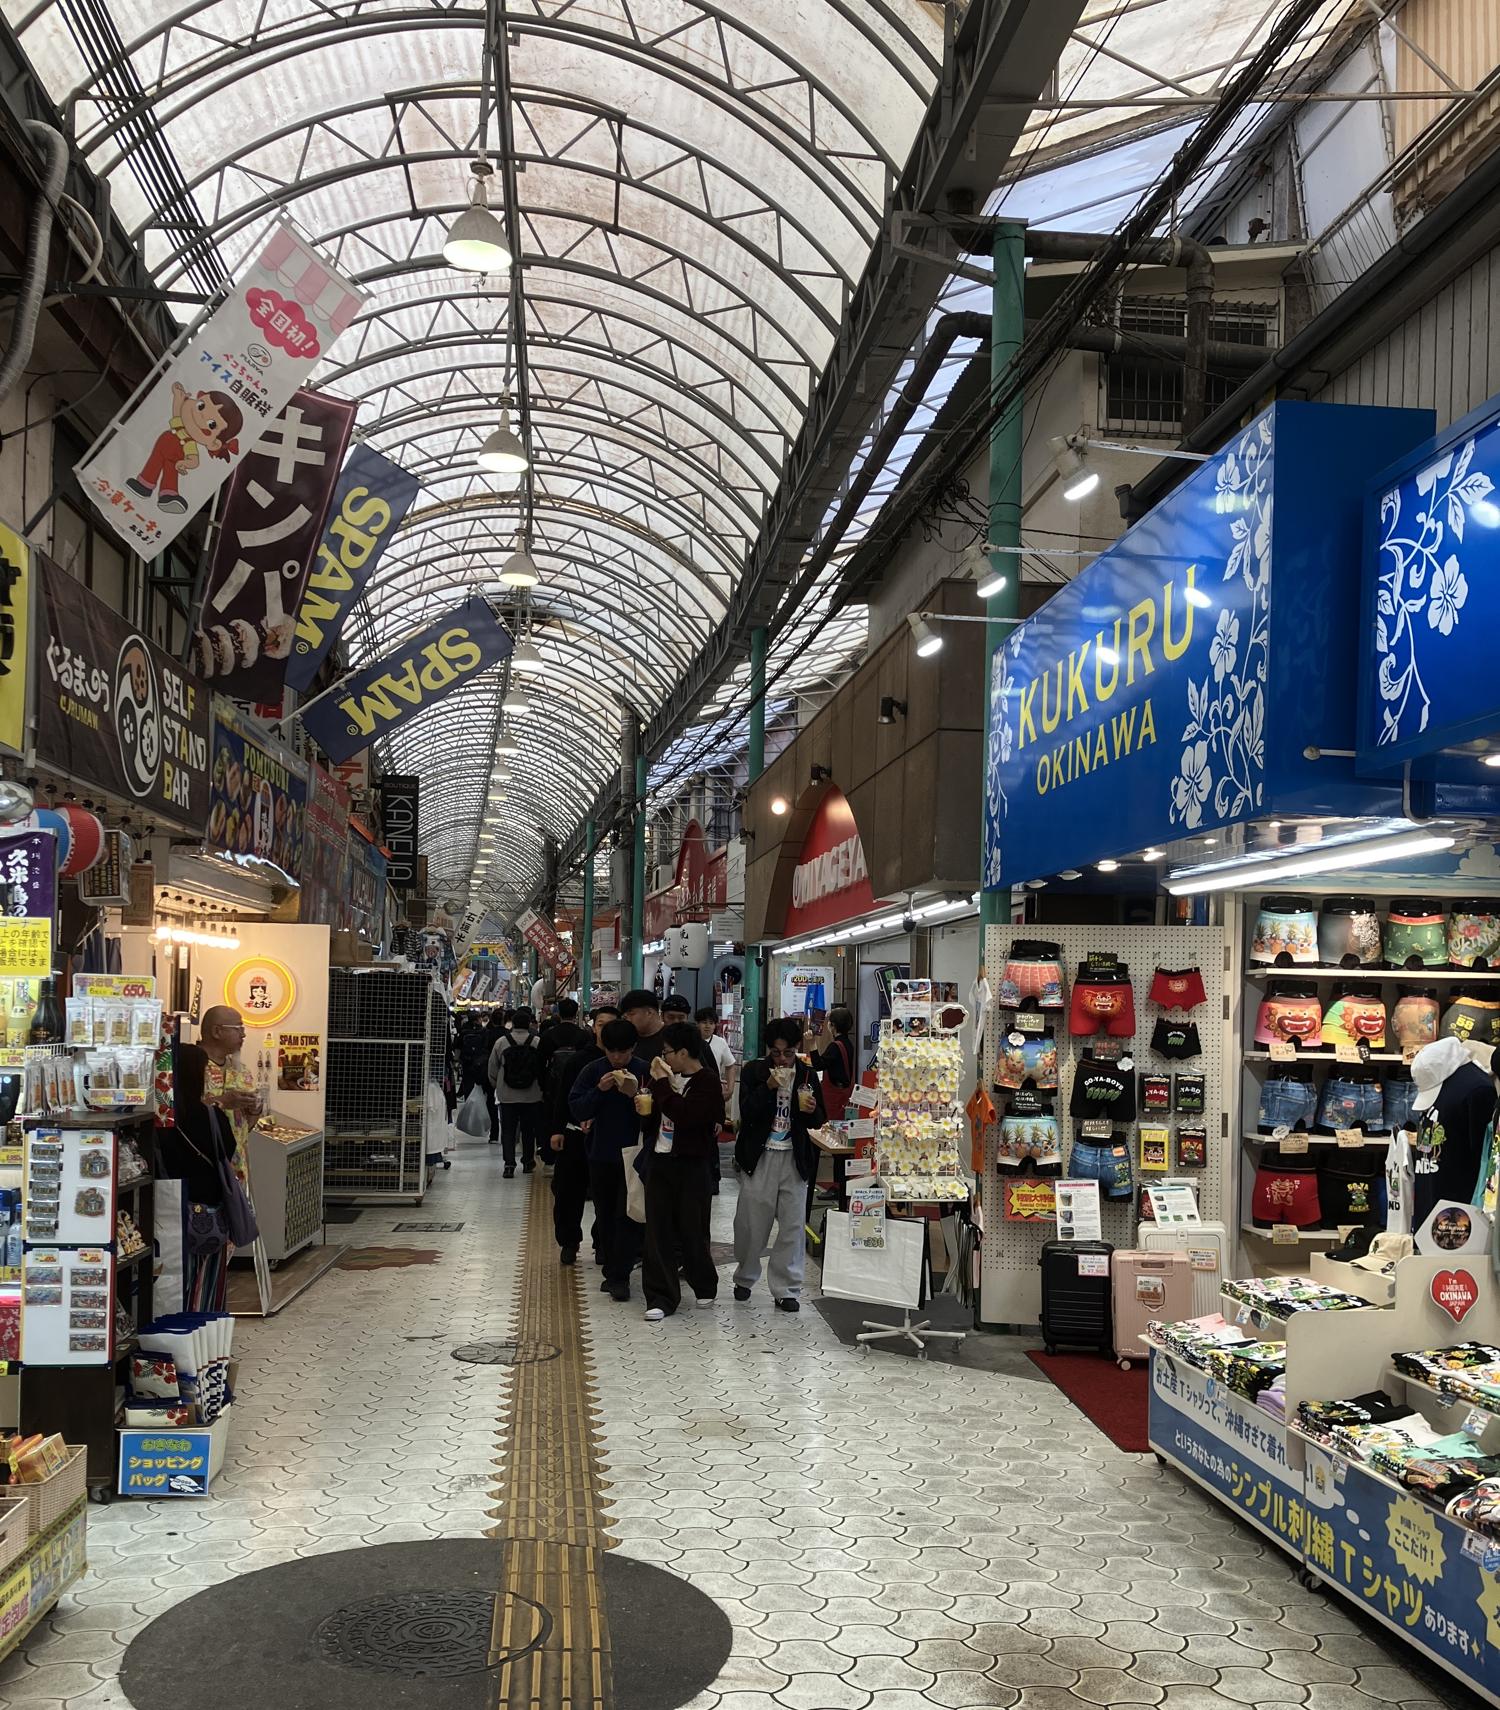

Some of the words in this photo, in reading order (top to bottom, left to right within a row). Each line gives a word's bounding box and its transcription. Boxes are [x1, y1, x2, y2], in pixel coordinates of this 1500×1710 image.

[200, 350, 274, 418] アイス自販機
[223, 353, 269, 396] ペコちゃんの
[1018, 563, 1196, 750] KUKURU
[163, 667, 195, 721] SELF
[163, 714, 206, 772] STAND
[1036, 699, 1158, 796] OKINAWA
[163, 761, 190, 810] BAR
[280, 1035, 299, 1046] SPAM
[300, 1035, 320, 1046] STICK
[1440, 1291, 1472, 1301] OKINAWA
[129, 1456, 204, 1470] ショッピング
[129, 1472, 168, 1487] バッグ
[1394, 1527, 1435, 1567] ここだけ!
